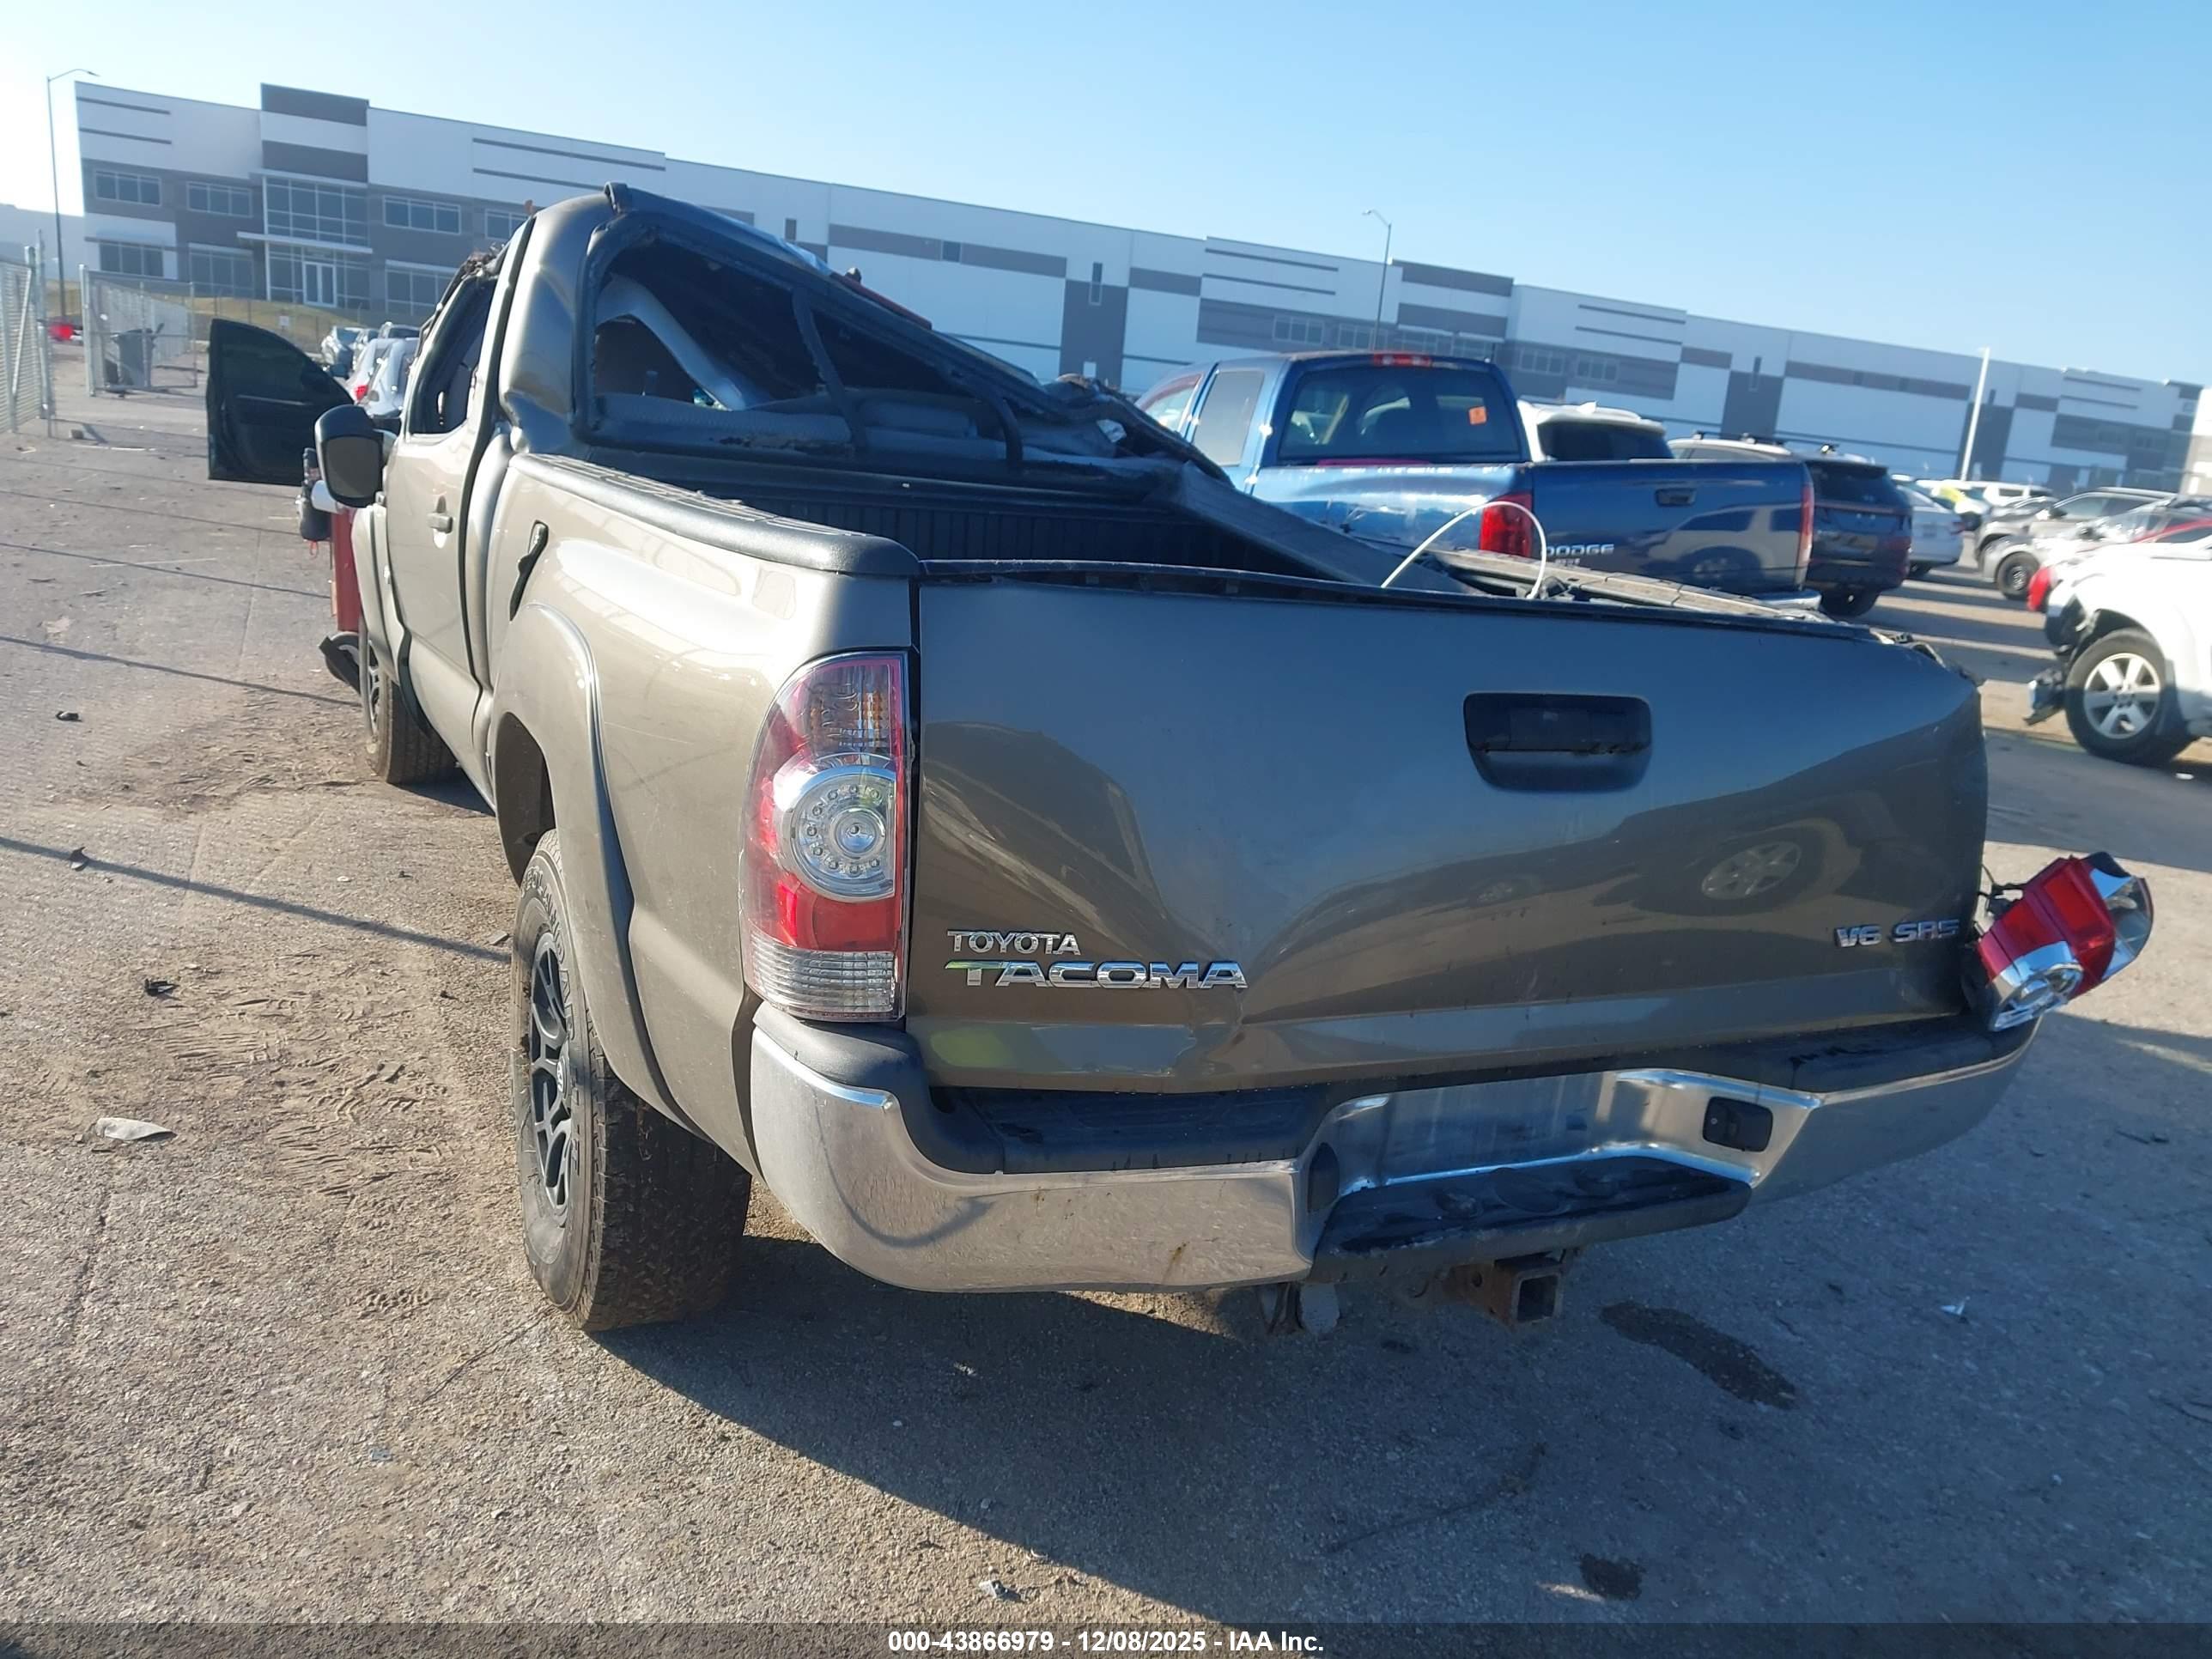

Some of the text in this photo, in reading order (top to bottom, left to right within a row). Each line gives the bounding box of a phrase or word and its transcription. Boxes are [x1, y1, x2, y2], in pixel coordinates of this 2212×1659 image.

[947, 930, 1081, 956] TOYOTA
[1836, 919, 1960, 948] V6 SR5
[945, 960, 1249, 989] TACOMA
